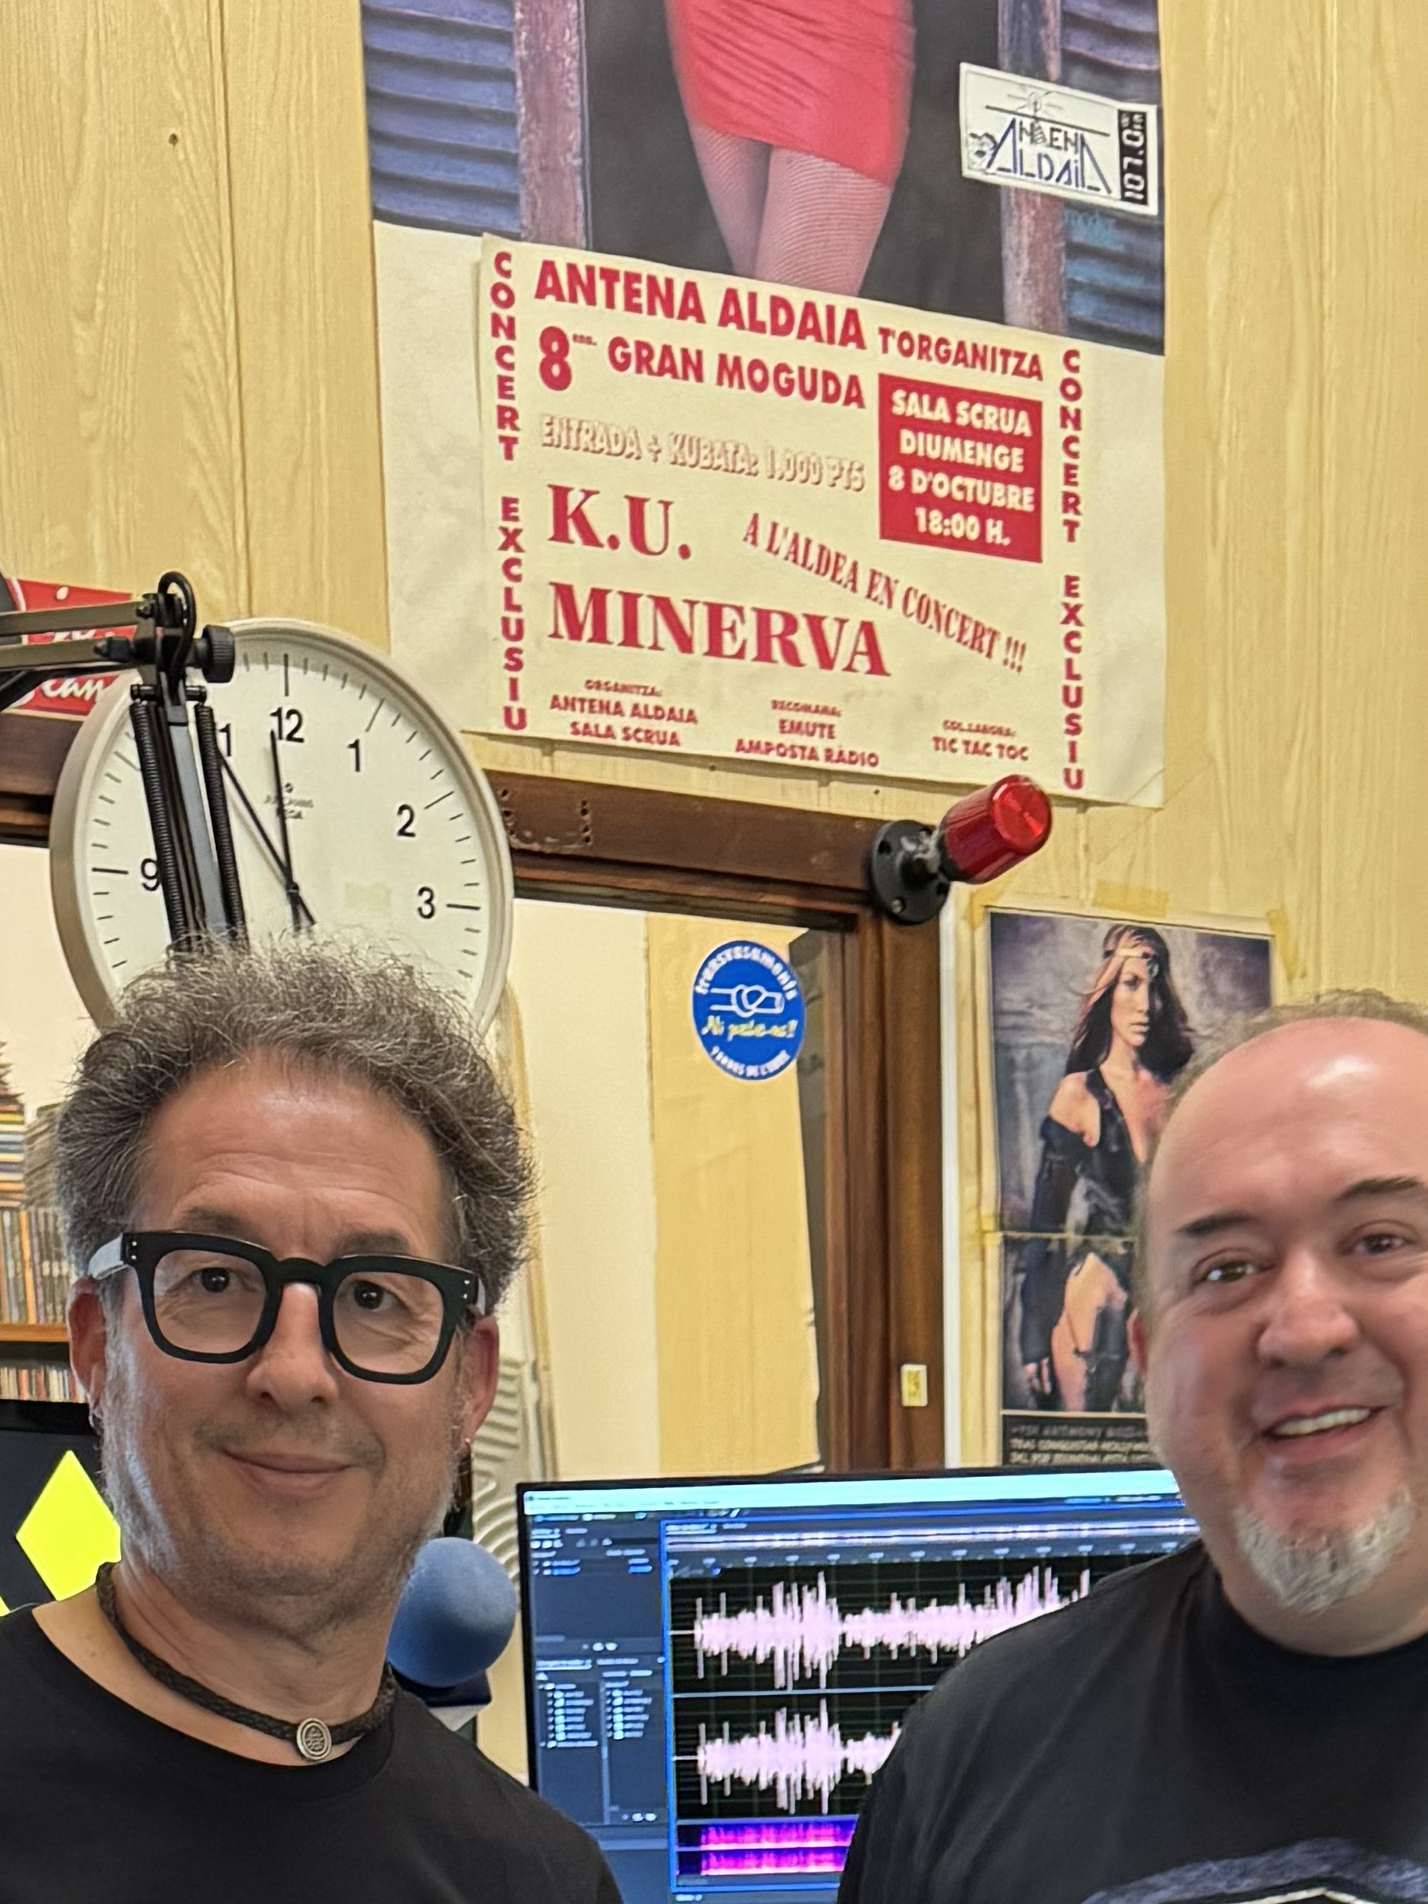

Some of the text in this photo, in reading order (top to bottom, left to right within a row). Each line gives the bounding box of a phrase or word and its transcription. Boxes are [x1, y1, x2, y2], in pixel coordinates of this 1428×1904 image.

[535, 259, 1044, 381] ANTENA ALDAIA T'ORGANITZA
[607, 335, 704, 384] GRAN
[715, 352, 866, 409] MOGUDA
[891, 389, 1032, 437] SALA SCRUA
[539, 413, 643, 461] ENTRADA
[645, 438, 663, 464] +
[899, 429, 1025, 474] DIUMENGE
[490, 251, 527, 732] CONCERT EXCLUSIU
[887, 465, 1036, 514] 8 D'OCTUBRE
[546, 483, 693, 561] K.U.
[915, 506, 1012, 547] 18:00 H.
[1059, 349, 1086, 791] CONCERT EXCLUSIU
[742, 512, 1027, 673] A L'ALDEA EN CONCERT !!!
[547, 581, 892, 677] MINERVA
[269, 706, 305, 744] 12
[549, 694, 699, 725] ANTENA ALDAIA
[778, 718, 837, 740] EMUTE
[346, 738, 361, 773] 1
[569, 720, 682, 748] SALA SCRUA
[734, 738, 820, 763] AMPOSTA
[932, 736, 1029, 761] TIC TAC TOC
[396, 803, 417, 838] 2
[140, 857, 161, 892] 9
[417, 886, 436, 919] 3
